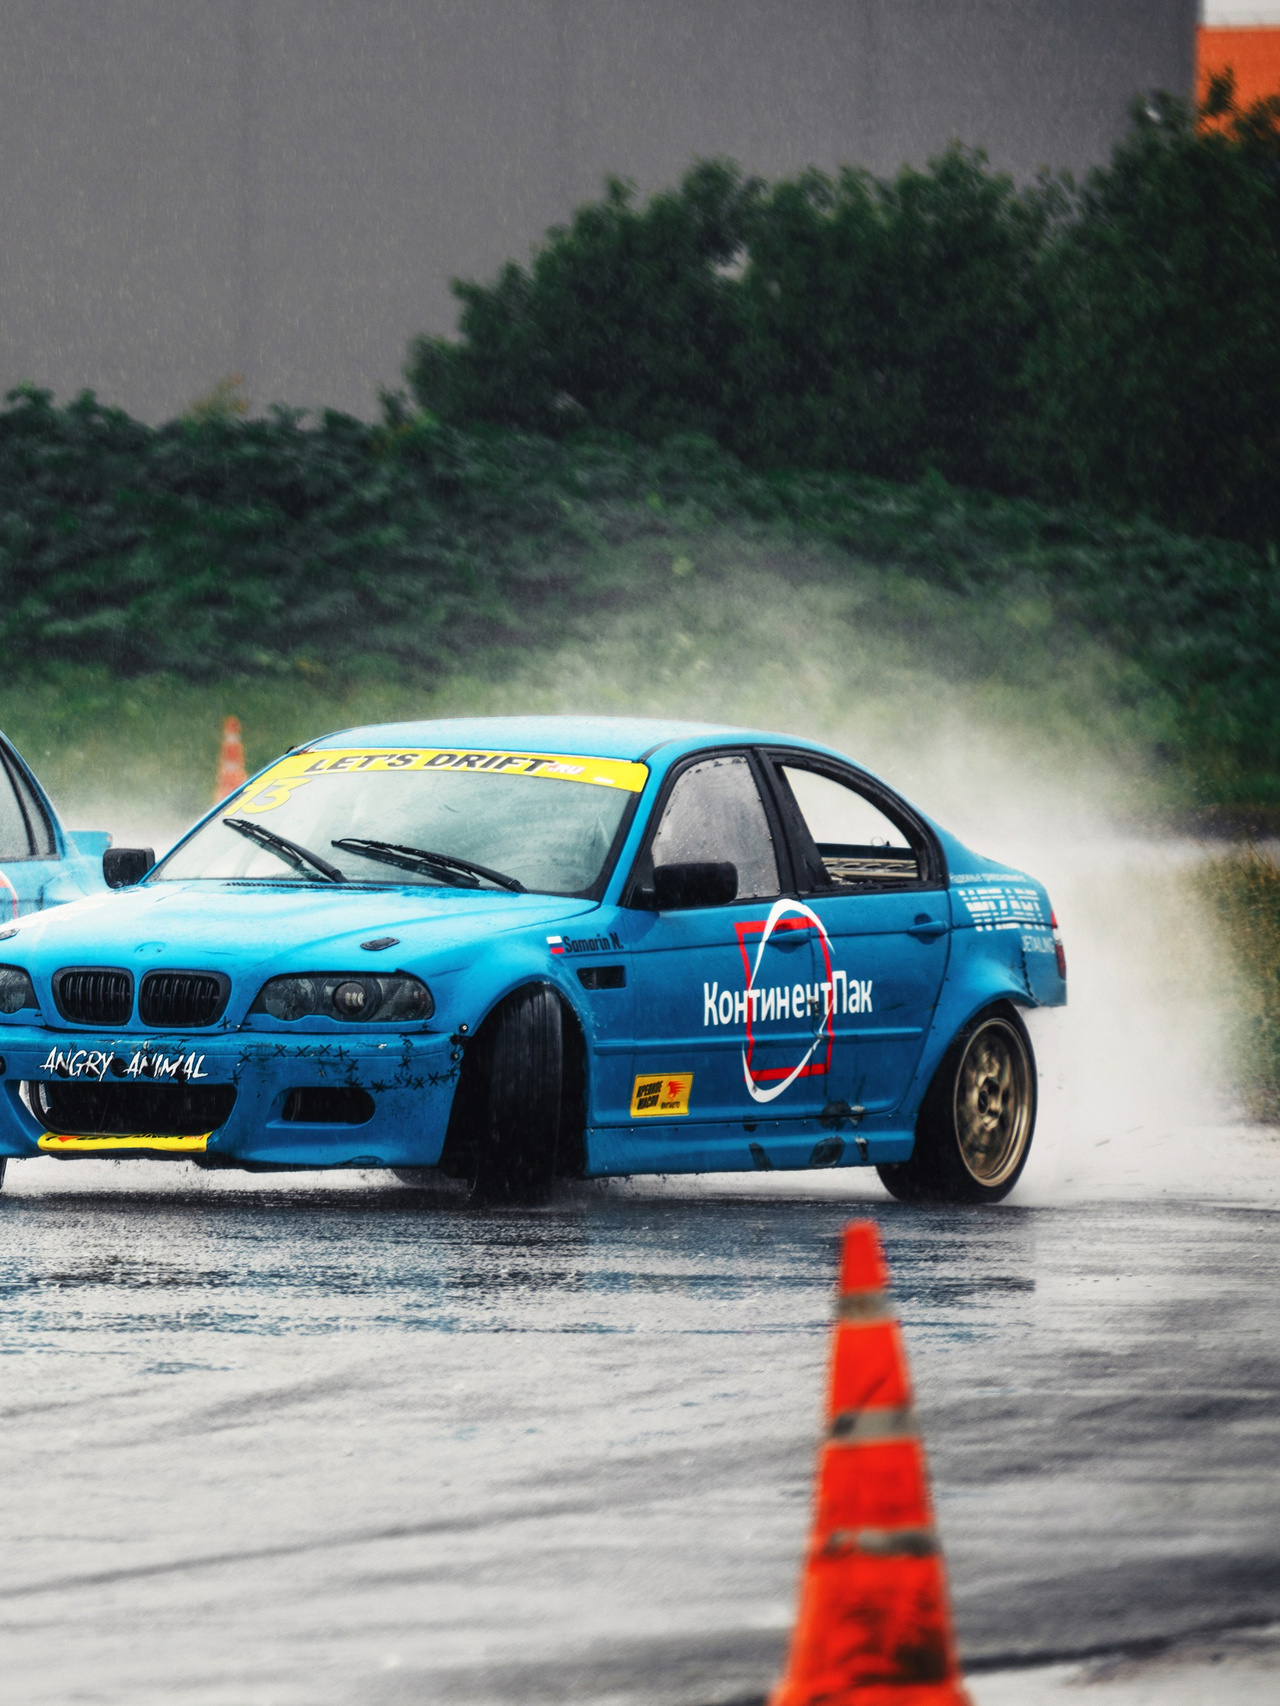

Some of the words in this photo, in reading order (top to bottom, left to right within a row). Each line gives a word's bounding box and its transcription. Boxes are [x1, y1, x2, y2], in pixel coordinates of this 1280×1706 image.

[304, 753, 420, 775] LET'S
[222, 777, 312, 816] 13
[563, 934, 611, 953] Samarin
[609, 932, 624, 950] N.
[703, 970, 873, 1026] КонтинентПак
[39, 1046, 115, 1082] ANGRY
[123, 1051, 208, 1081] ANIMAL
